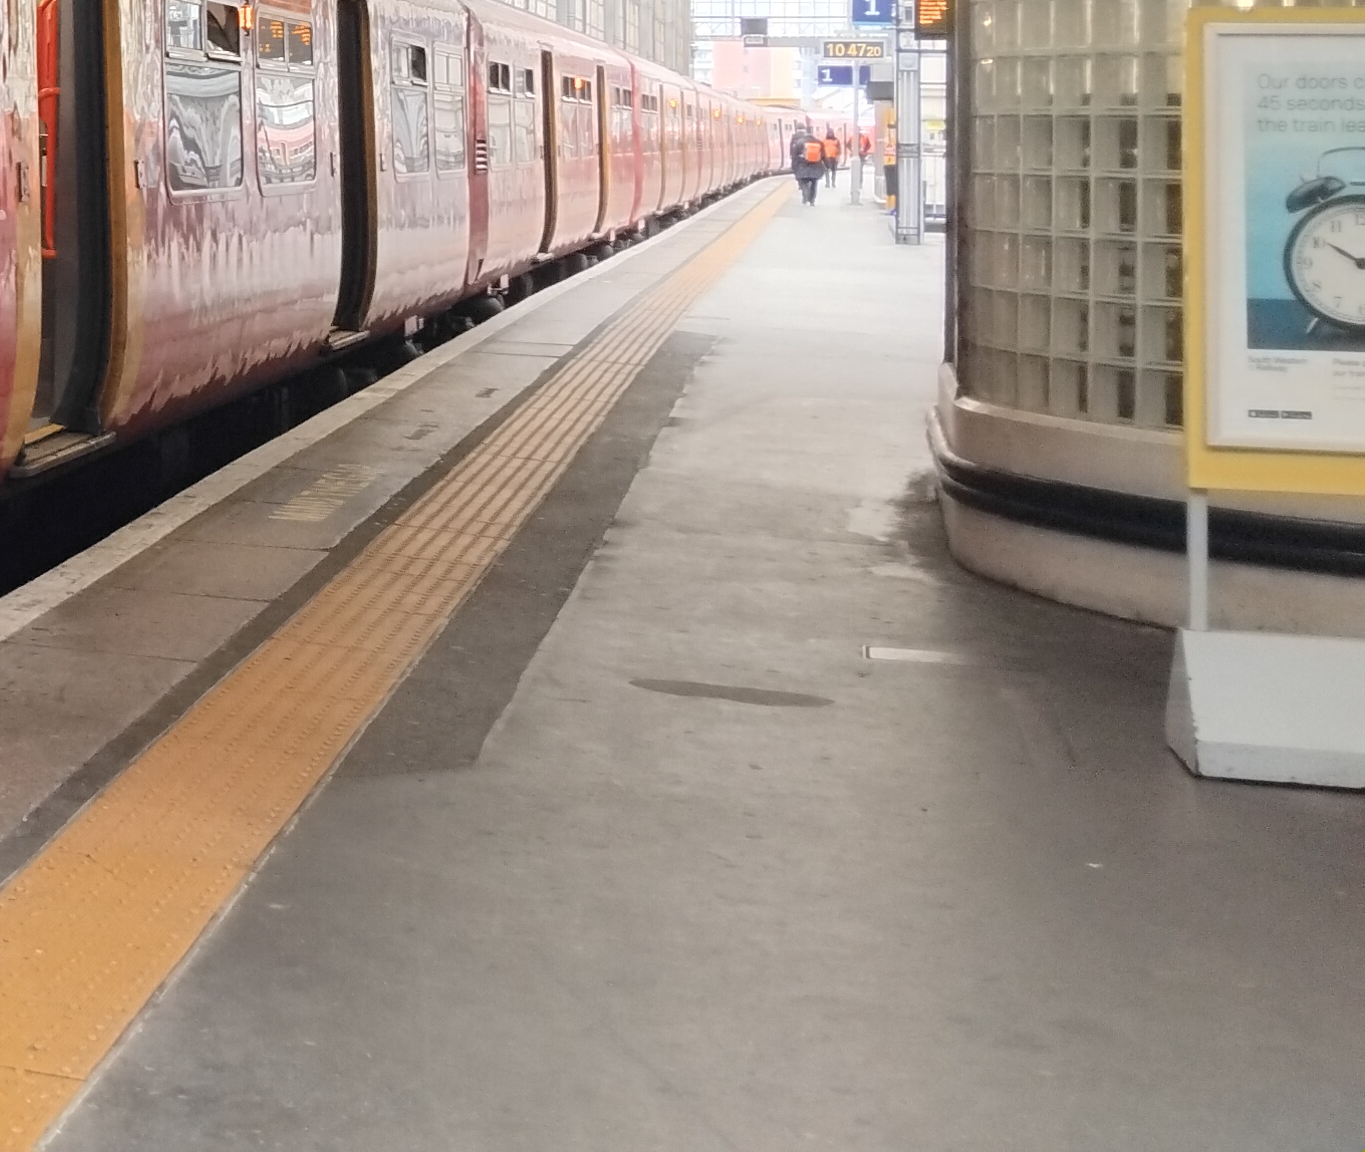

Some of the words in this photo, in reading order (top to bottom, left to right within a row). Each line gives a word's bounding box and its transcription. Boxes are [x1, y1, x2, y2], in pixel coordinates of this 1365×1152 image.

[821, 68, 833, 82] 1
[1296, 73, 1348, 90] doors
[1257, 117, 1288, 133] the
